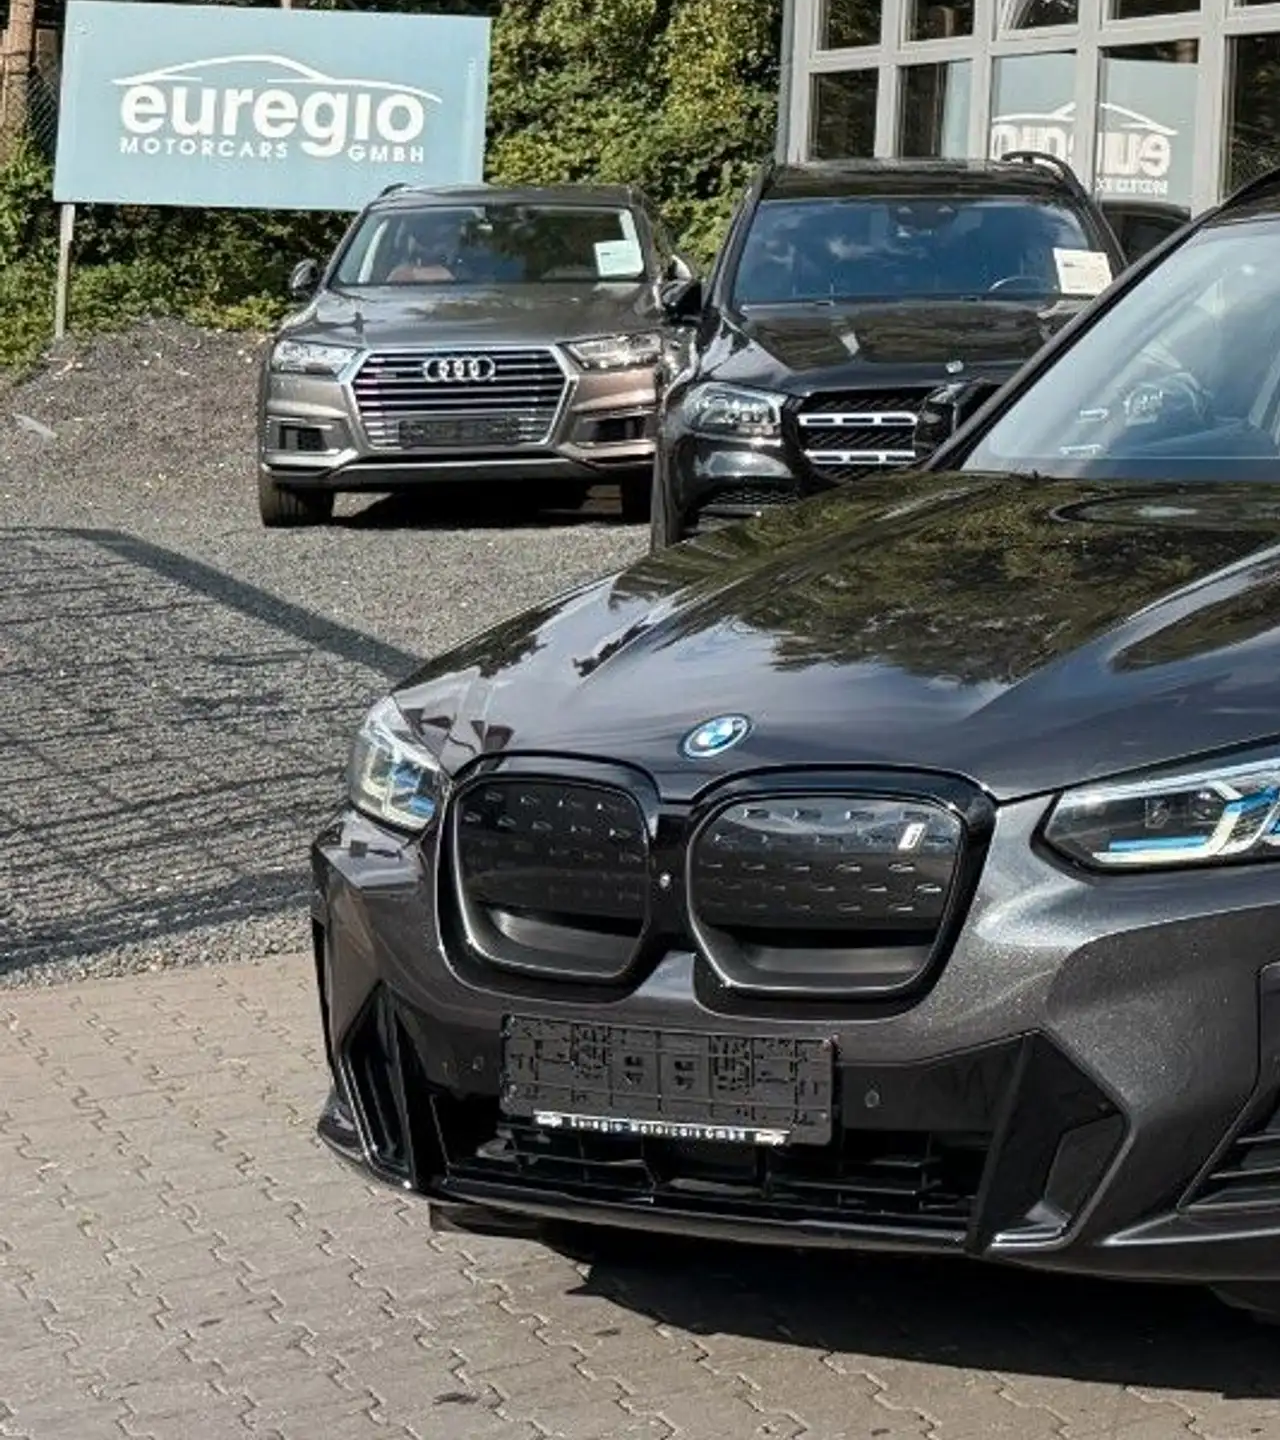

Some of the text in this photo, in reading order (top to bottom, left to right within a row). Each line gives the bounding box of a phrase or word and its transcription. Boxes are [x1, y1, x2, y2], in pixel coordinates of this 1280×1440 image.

[119, 82, 426, 158] euregio
[119, 136, 425, 163] MOTORCARS GMBH
